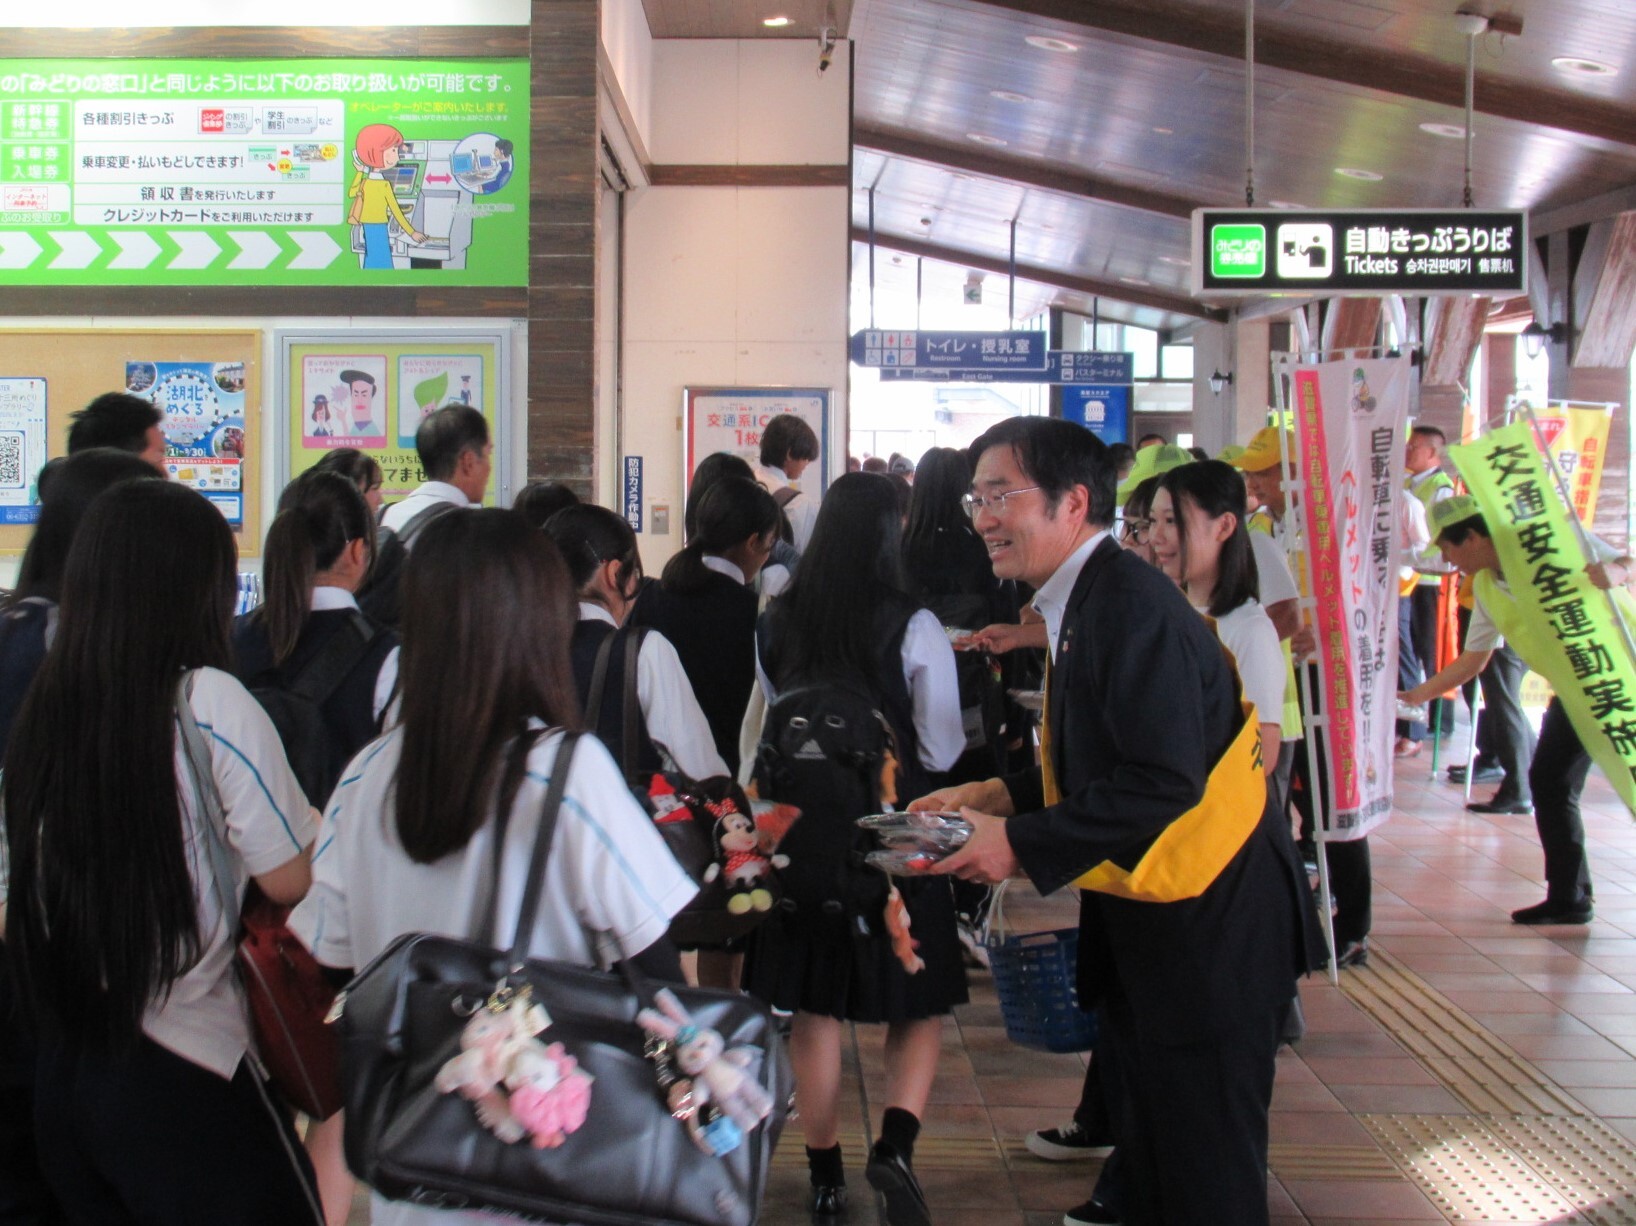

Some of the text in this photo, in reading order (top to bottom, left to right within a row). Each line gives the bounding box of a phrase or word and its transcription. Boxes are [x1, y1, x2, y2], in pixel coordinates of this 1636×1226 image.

[83, 112, 174, 125] 各種割引きっぷ
[268, 111, 284, 120] 学生
[268, 120, 285, 130] 割引
[12, 164, 60, 179] 入場券
[103, 208, 314, 222] クレジットカードをご利用いただけます
[1216, 239, 1262, 251] みどりの
[1346, 227, 1513, 253] 自動きっぷうりば
[1345, 256, 1399, 274] Tickets
[926, 338, 1031, 355] トイレ・授乳室
[930, 355, 962, 363] Restroom
[983, 355, 1008, 364] Nursing
